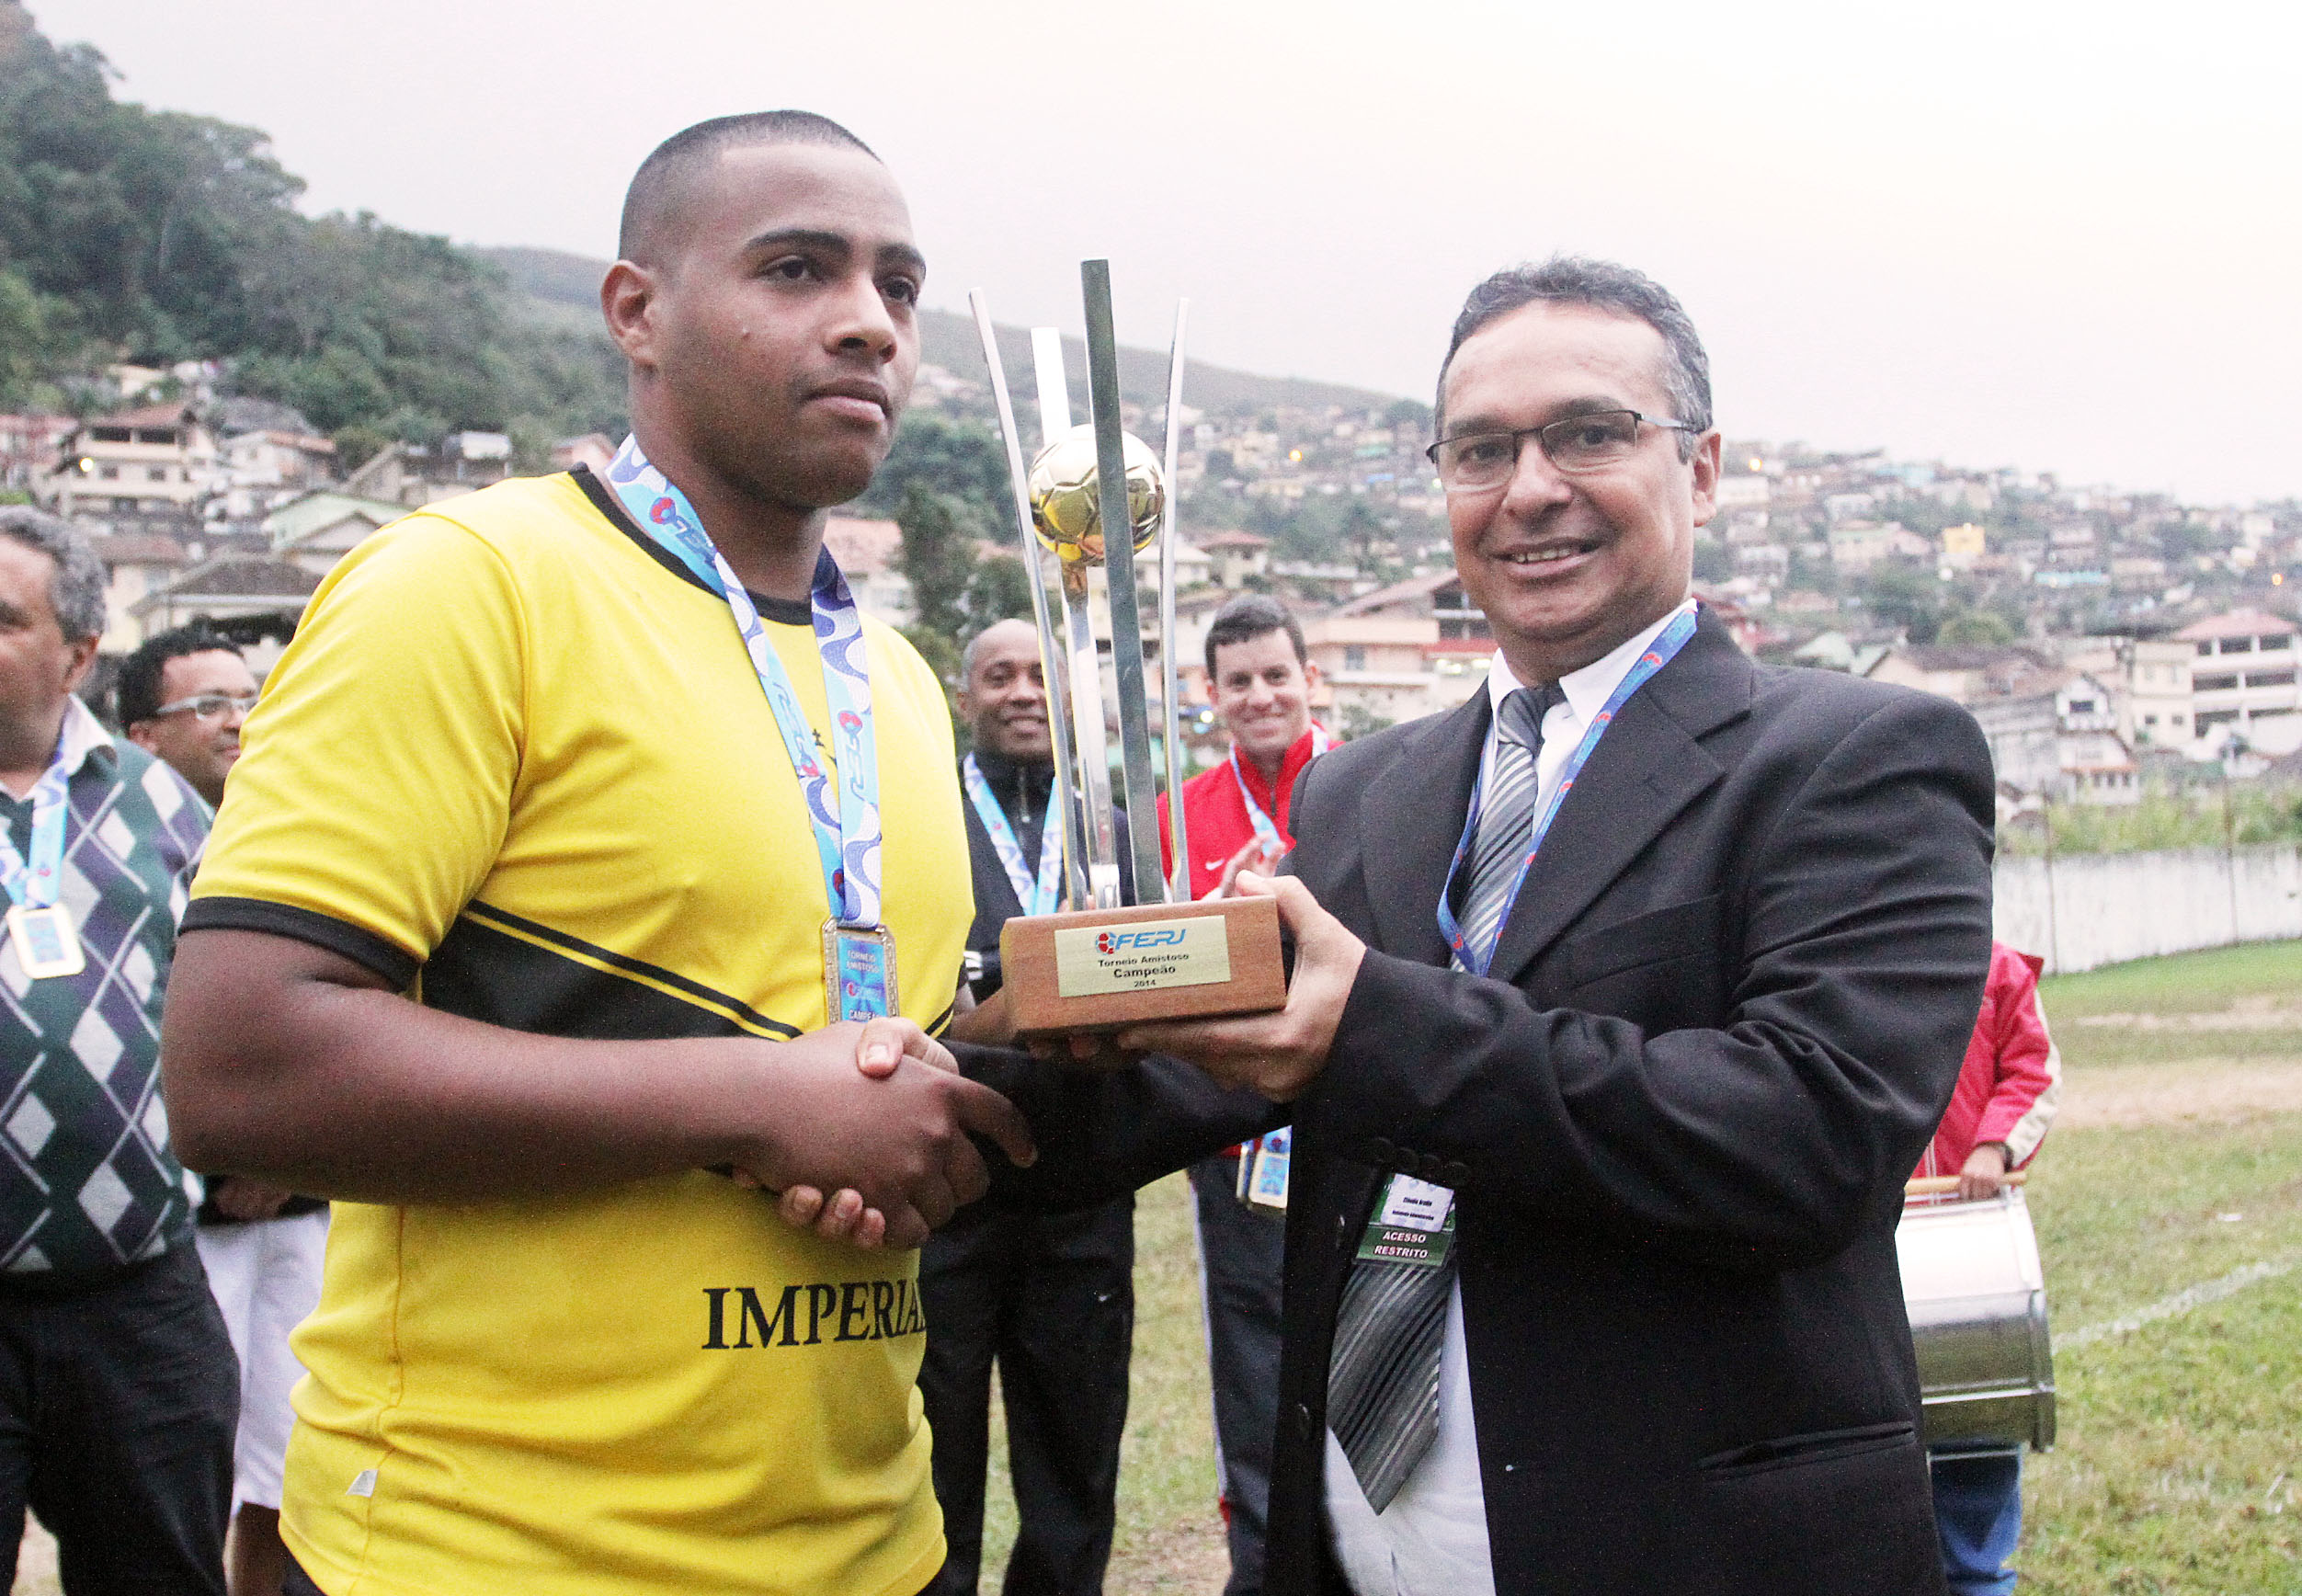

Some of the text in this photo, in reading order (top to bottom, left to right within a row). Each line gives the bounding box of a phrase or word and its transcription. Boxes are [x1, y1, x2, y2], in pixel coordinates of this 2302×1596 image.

[1115, 929, 1187, 950] FERJ
[1098, 952, 1190, 967] Torneio Amistoso
[1113, 965, 1176, 979] Campeão
[1134, 979, 1157, 987] 2014
[1382, 1231, 1427, 1243] ACESSO
[1374, 1245, 1428, 1259] RESTRITO
[701, 1279, 927, 1350] IMPERIA
